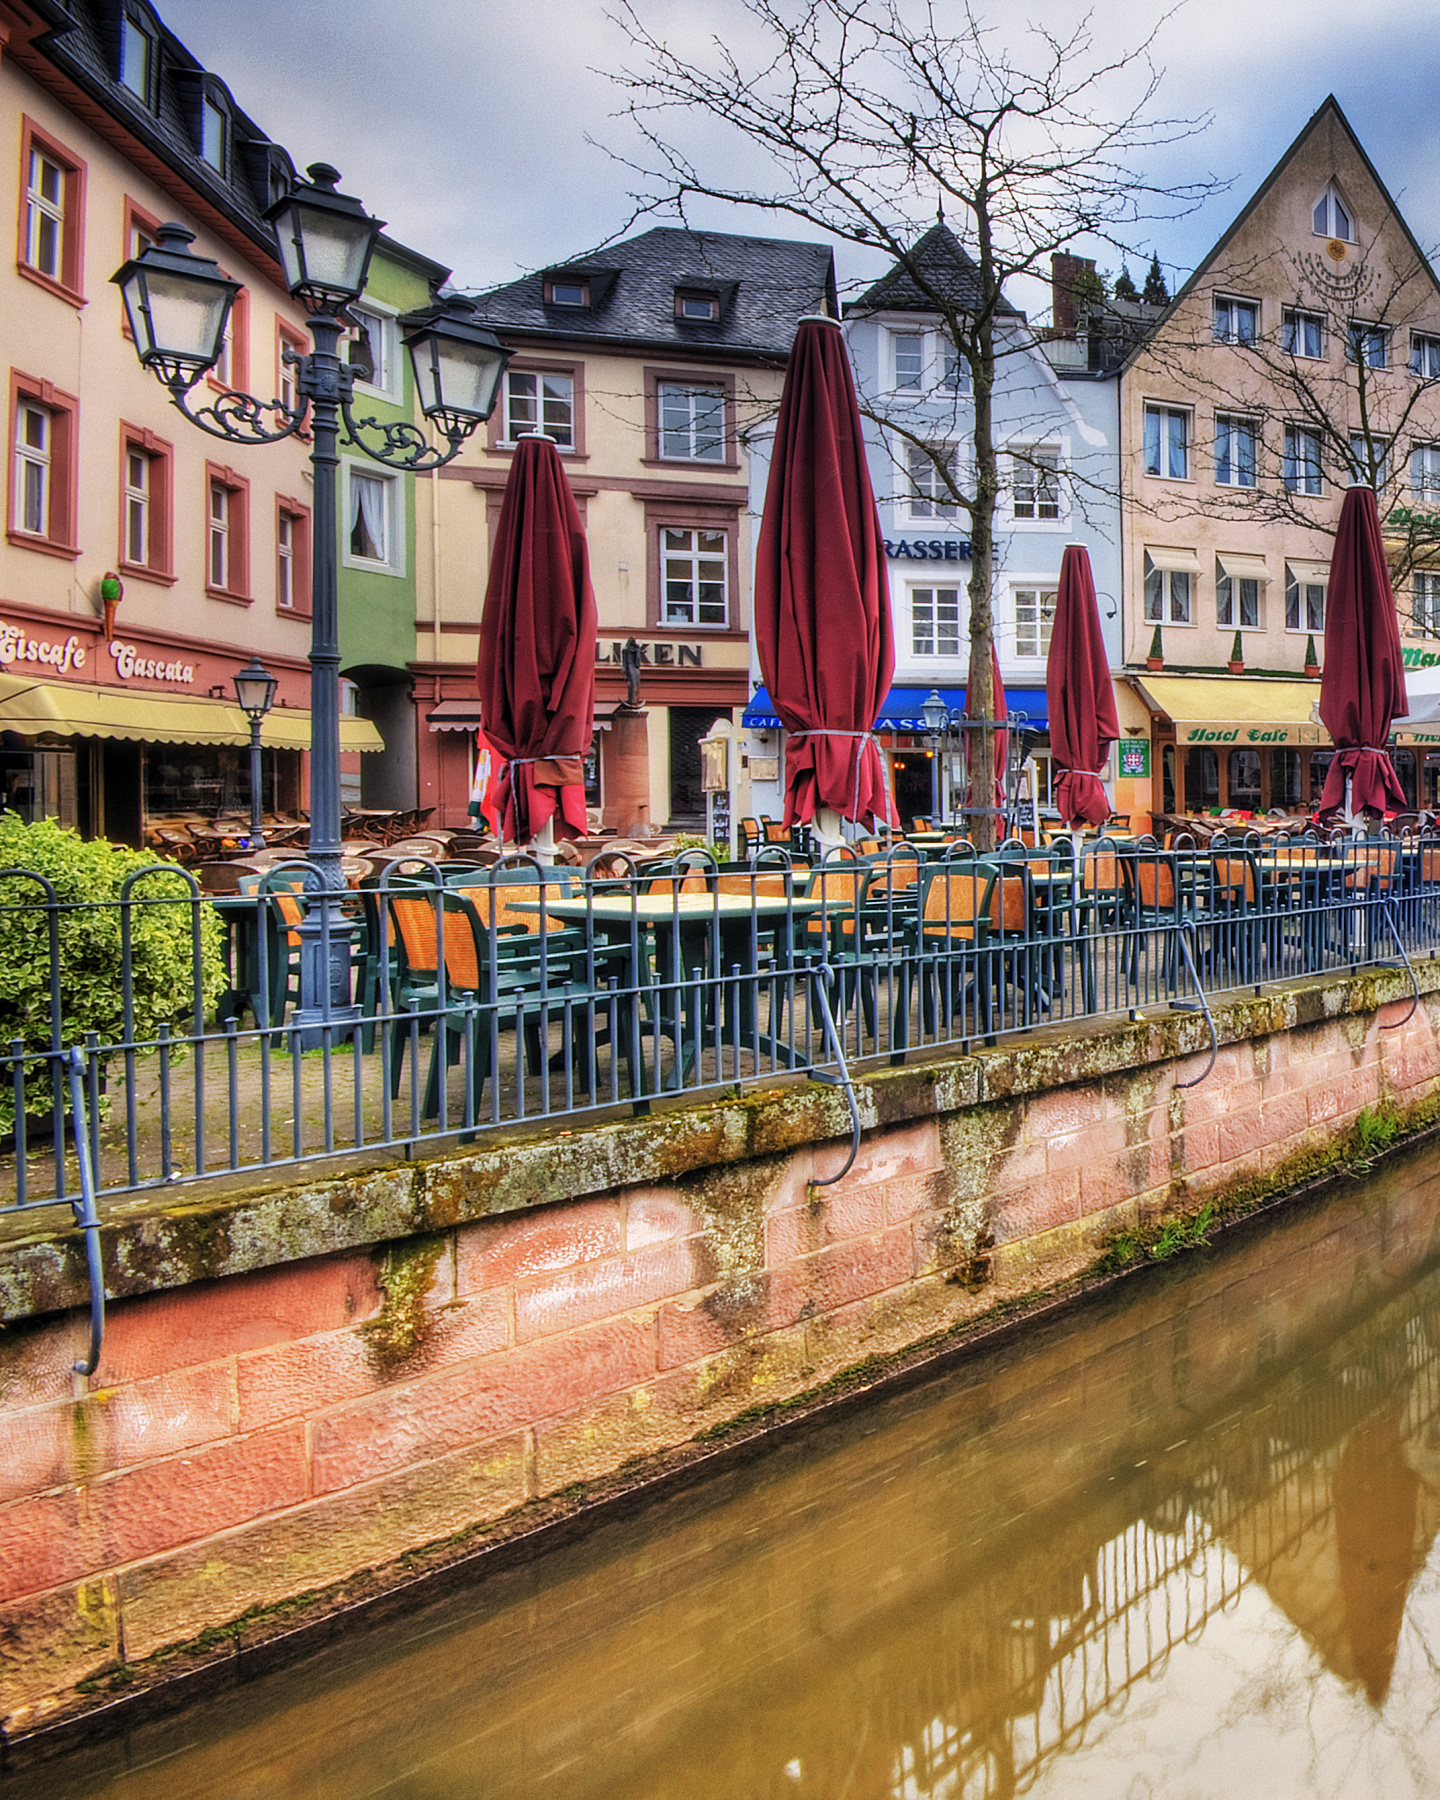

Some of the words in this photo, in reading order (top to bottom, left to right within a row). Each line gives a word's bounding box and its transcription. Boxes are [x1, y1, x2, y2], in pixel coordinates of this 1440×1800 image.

[883, 539, 999, 560] RASSERE
[0, 620, 86, 673] Eiscafe
[109, 640, 194, 683] Cascata
[595, 641, 702, 665] LIKEN
[1187, 728, 1240, 742] Hotel
